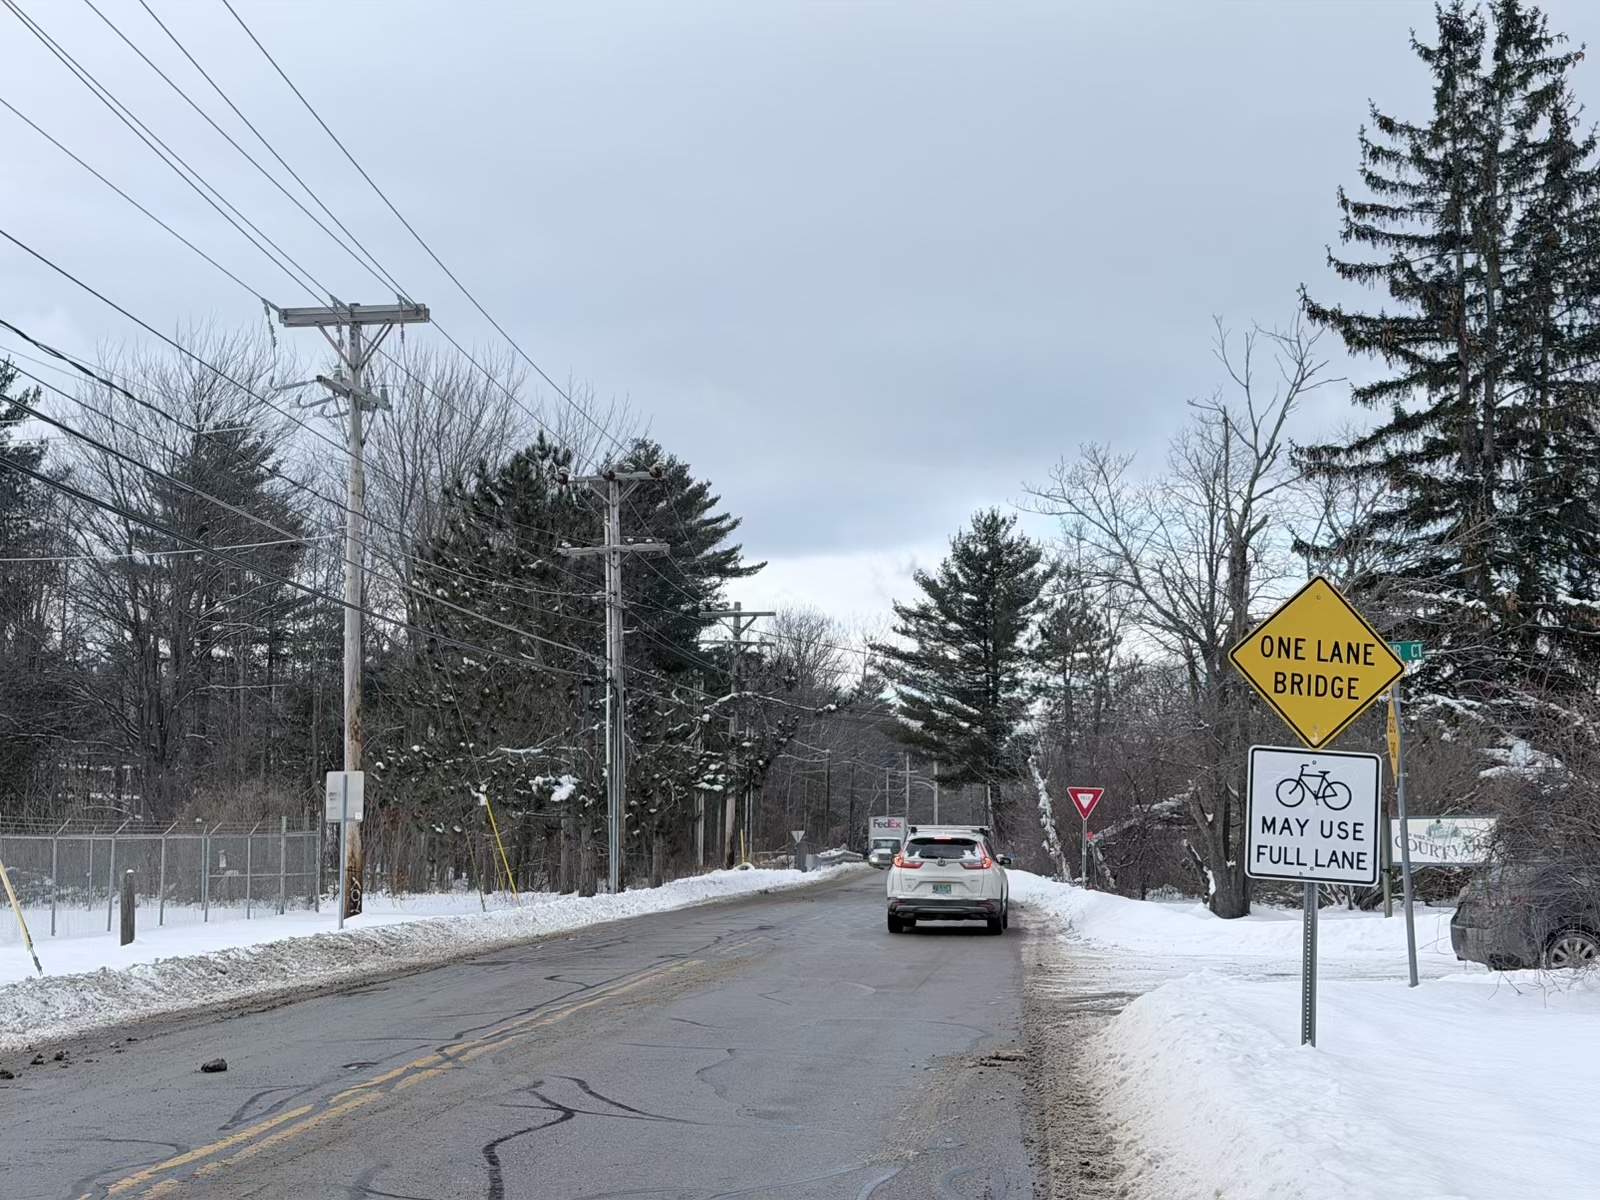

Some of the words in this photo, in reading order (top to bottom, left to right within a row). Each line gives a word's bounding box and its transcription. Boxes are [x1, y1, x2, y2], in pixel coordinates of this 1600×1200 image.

[1260, 635, 1306, 660] ONE
[1317, 640, 1375, 666] LANE
[1410, 644, 1423, 658] CT
[1273, 671, 1359, 700] BRIDGE
[872, 818, 902, 829] FedEx
[1261, 816, 1310, 837] MAY
[1320, 820, 1365, 841] USE
[1256, 844, 1308, 867] FULL
[1314, 848, 1368, 871] LANE
